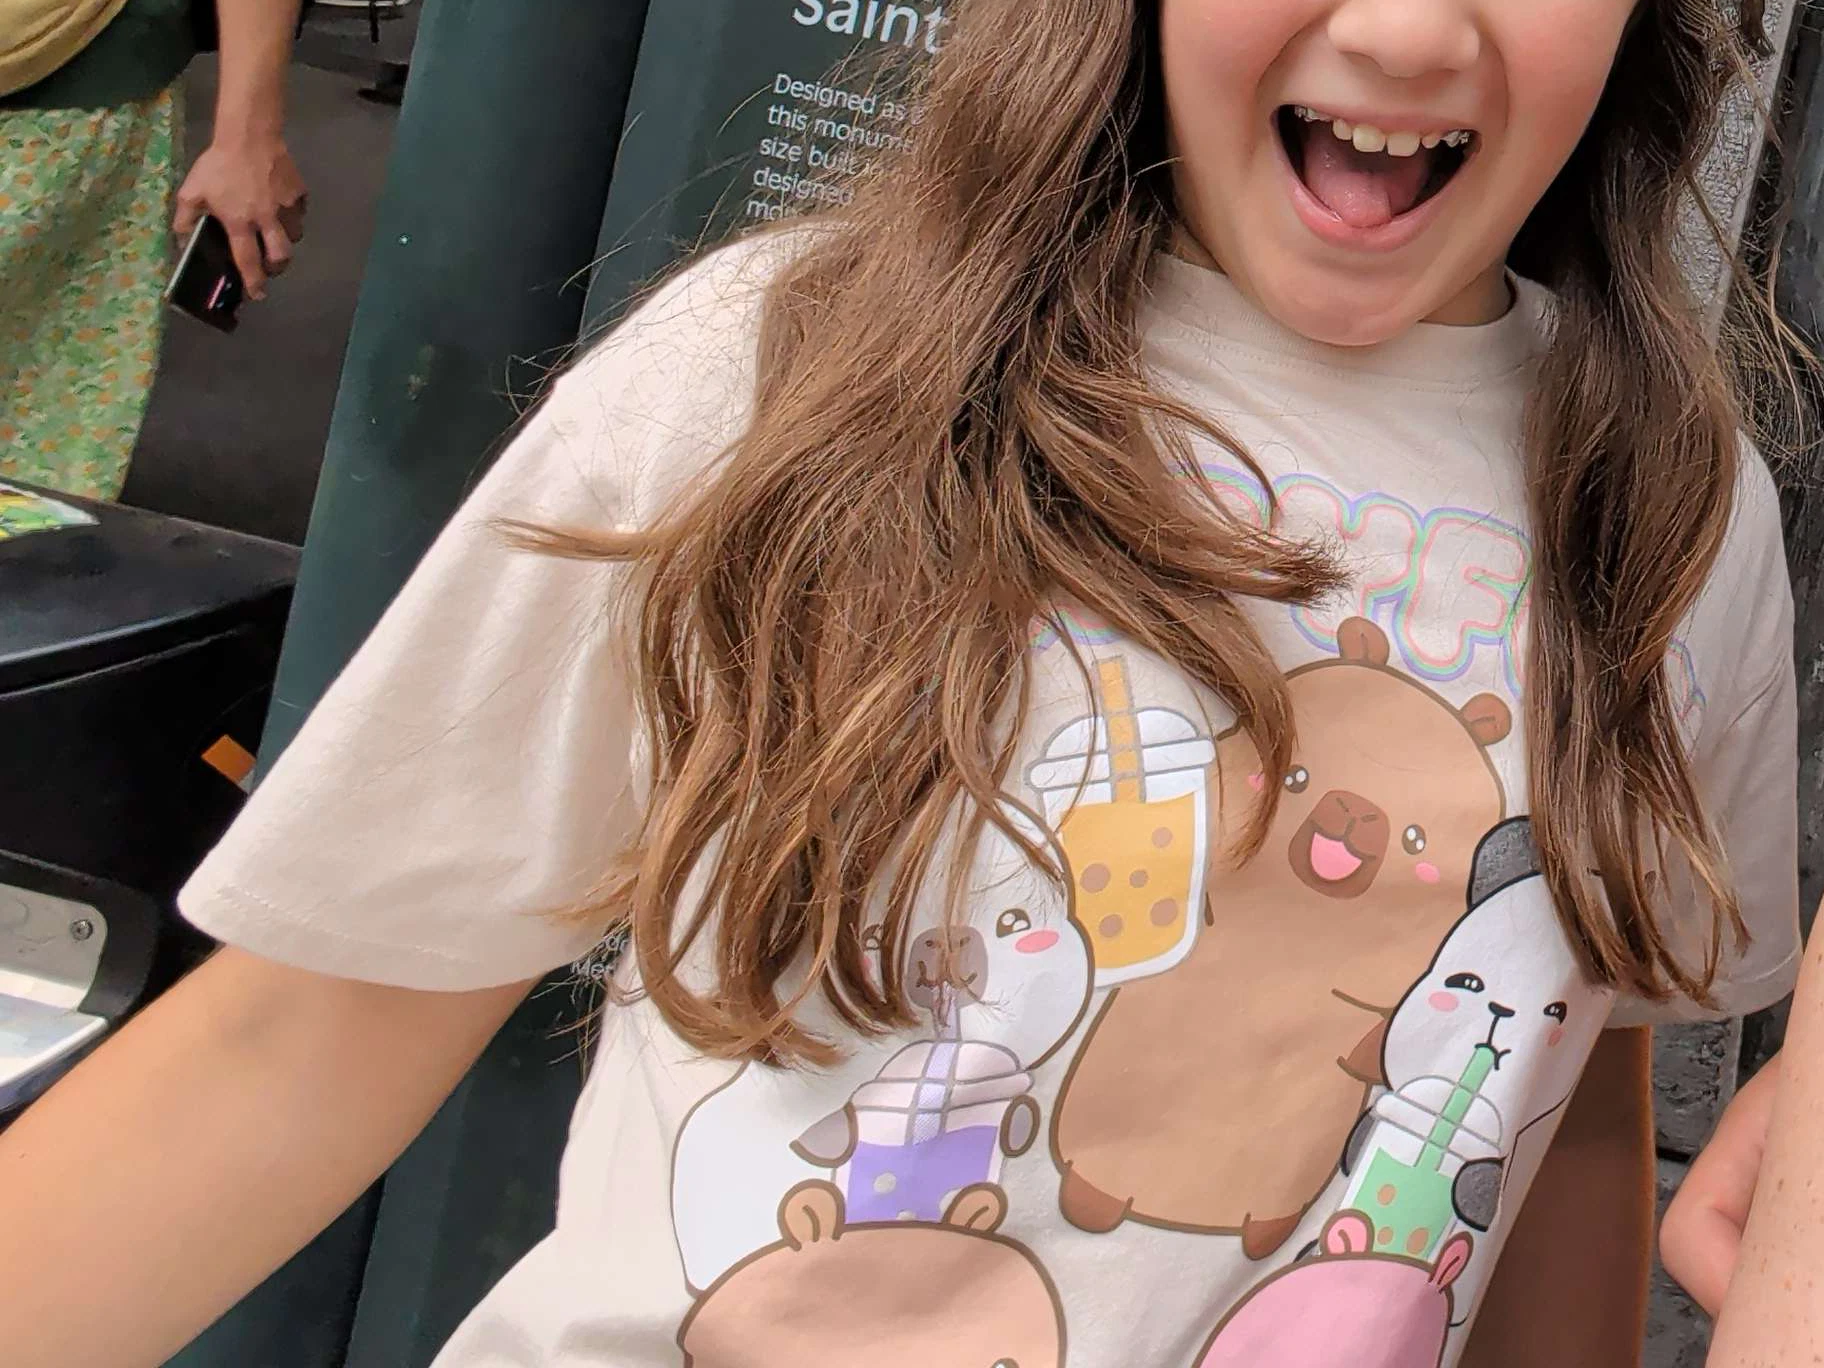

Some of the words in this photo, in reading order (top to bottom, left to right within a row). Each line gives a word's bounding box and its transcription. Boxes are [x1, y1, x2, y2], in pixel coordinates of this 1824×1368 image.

[773, 73, 877, 114] Designed
[881, 101, 907, 121] as
[767, 104, 808, 132] this
[759, 136, 803, 162] size
